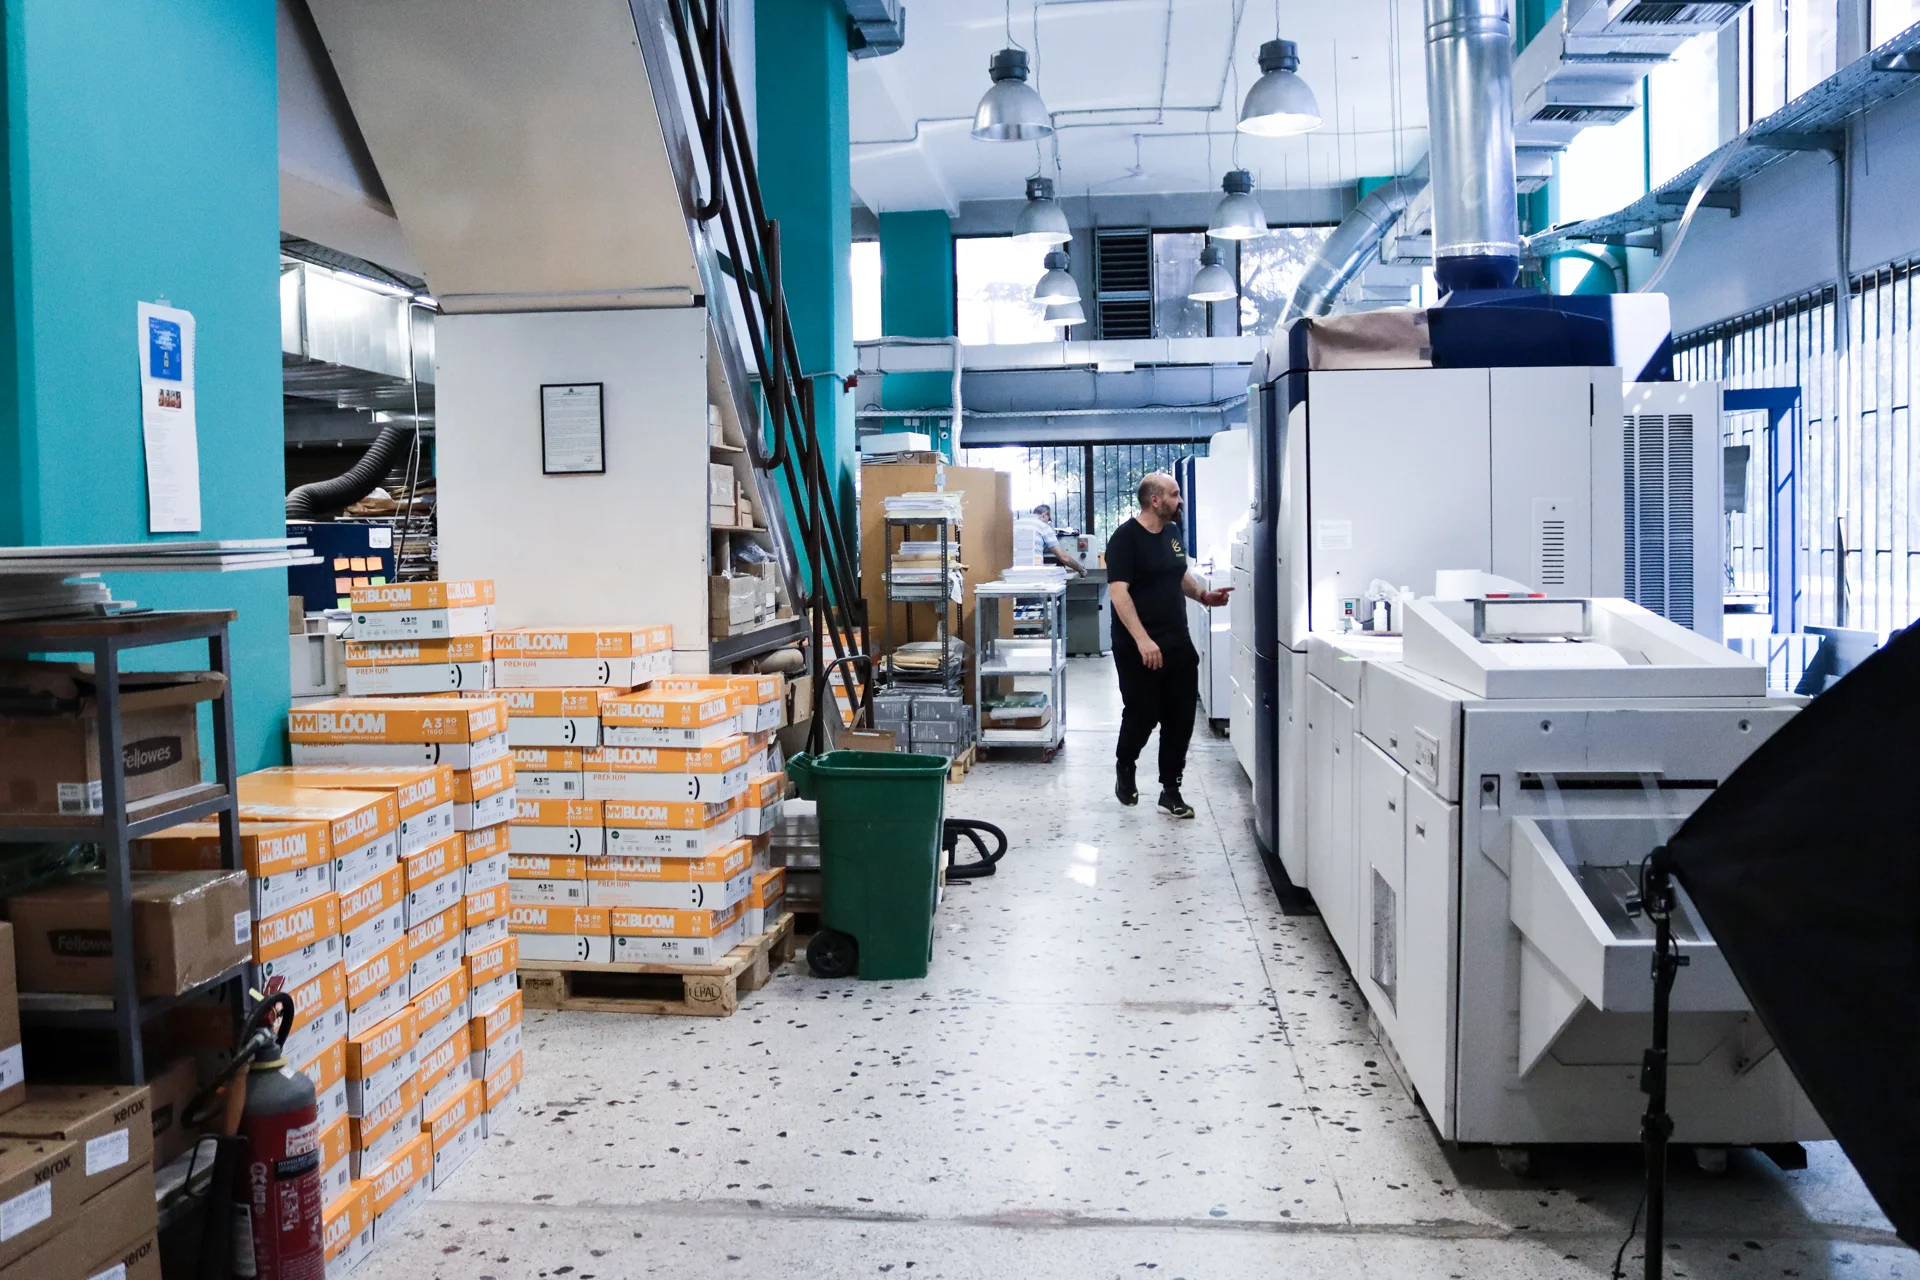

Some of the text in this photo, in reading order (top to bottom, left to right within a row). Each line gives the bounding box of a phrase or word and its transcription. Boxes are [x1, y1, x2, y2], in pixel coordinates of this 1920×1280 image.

[367, 588, 412, 603] BLOOM
[368, 642, 420, 660] BLOOM
[516, 634, 568, 650] BLOOM
[596, 637, 612, 647] A3
[356, 667, 389, 675] PREMIUM
[503, 660, 537, 668] PREMIUM
[562, 696, 577, 705] A3
[619, 703, 665, 718] BLOOM
[318, 712, 386, 734] BLOOM
[421, 717, 443, 729] A3
[122, 746, 171, 769] Fellowes
[513, 749, 548, 763] LOOM
[605, 747, 658, 764] BLOOM
[685, 752, 701, 762] A3
[410, 776, 436, 805] BLOOM
[567, 806, 582, 815] A3
[623, 805, 668, 820] BLOOM
[347, 806, 378, 840] BLOOM
[273, 832, 307, 860] BLOOM
[508, 855, 550, 870] BLOOM
[609, 855, 661, 873] BLOOM
[689, 861, 704, 871] A3
[352, 880, 382, 916] BLOOM
[275, 907, 315, 942] BLOOM
[574, 914, 590, 923] A3
[629, 913, 675, 929] BLOOM
[58, 934, 112, 952] Fellowe
[359, 955, 390, 992] BLOOM
[293, 979, 321, 1015] LOOM
[311, 1020, 319, 1032] A3
[373, 1023, 401, 1059] BLOOM
[114, 1099, 145, 1125] xerox
[372, 1089, 402, 1129] BLOOM
[34, 1155, 73, 1185] xerox
[385, 1154, 413, 1192] BLOOM
[323, 1211, 350, 1250] LOOM
[122, 1239, 154, 1268] xerox
